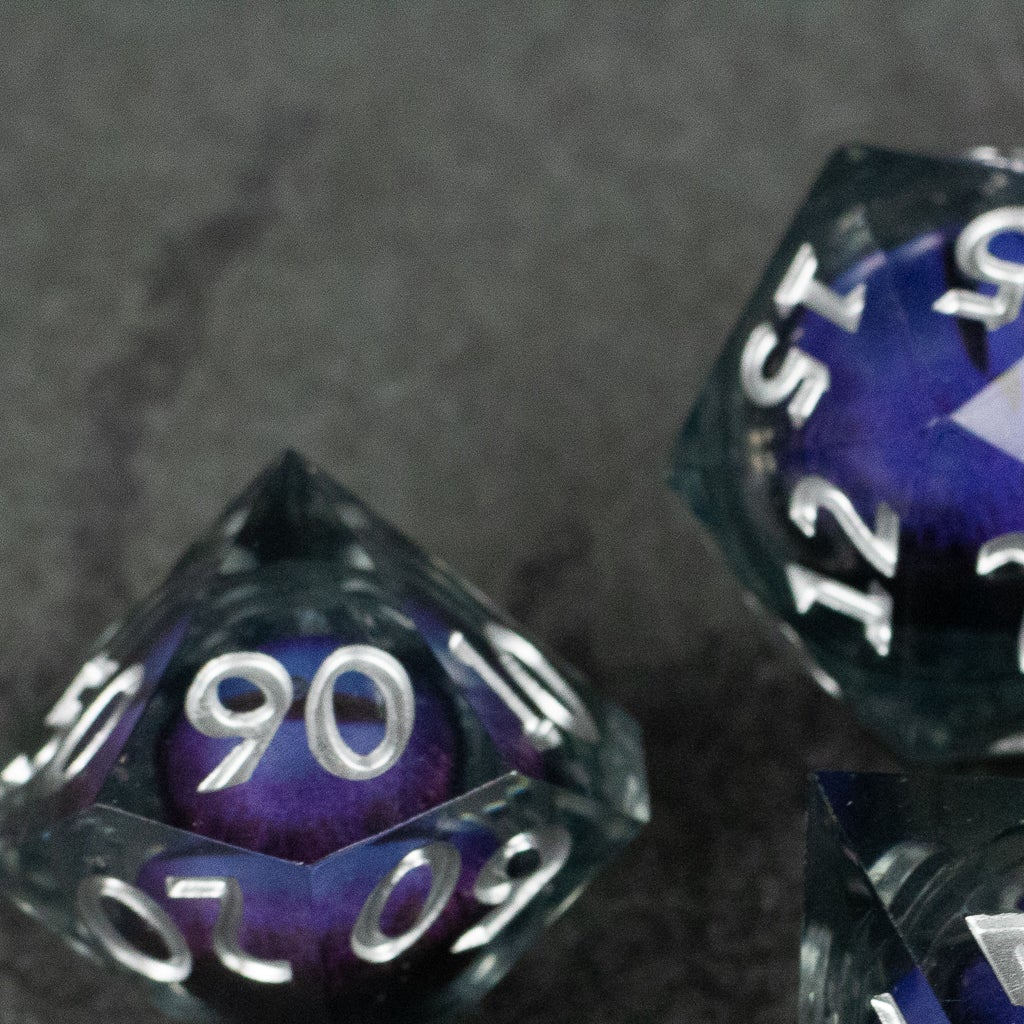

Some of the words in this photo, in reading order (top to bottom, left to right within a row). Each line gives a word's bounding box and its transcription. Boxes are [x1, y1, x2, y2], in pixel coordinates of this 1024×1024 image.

[739, 242, 866, 430] 15
[786, 475, 900, 658] 12
[185, 643, 416, 794] 90
